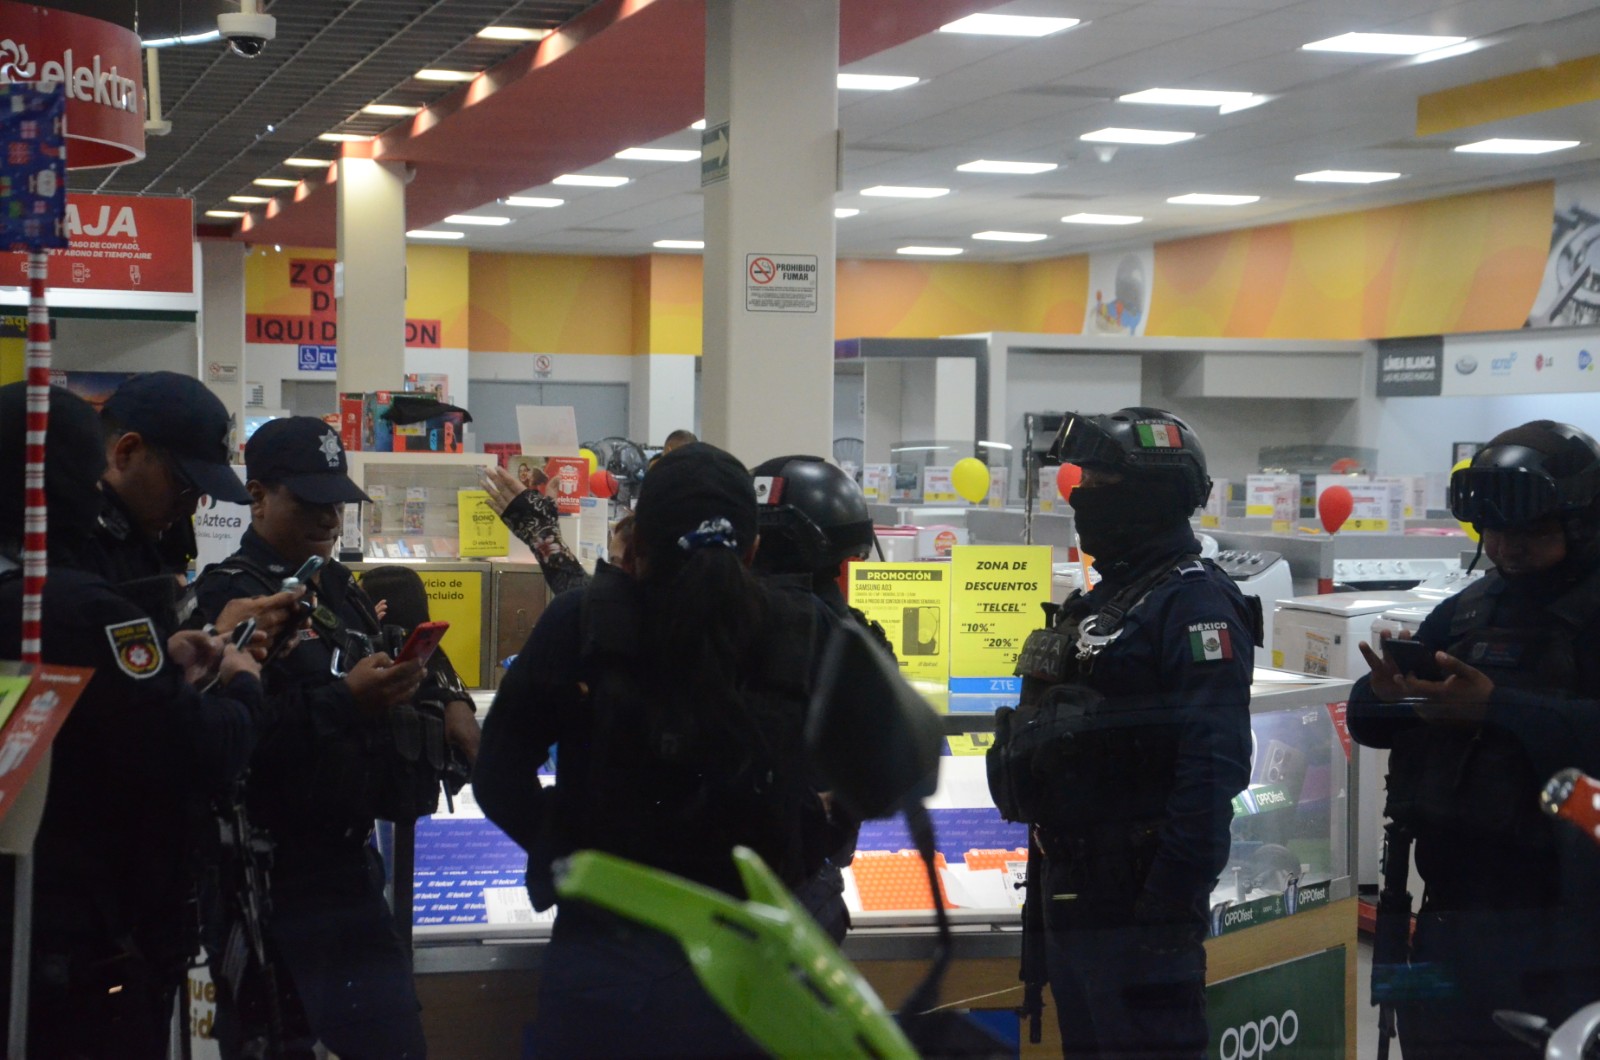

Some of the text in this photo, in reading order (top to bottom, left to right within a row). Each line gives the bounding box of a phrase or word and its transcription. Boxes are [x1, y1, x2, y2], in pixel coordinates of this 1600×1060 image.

[41, 48, 137, 113] elektra
[67, 203, 138, 237] AJA
[102, 242, 140, 250] CONTADO,
[776, 263, 816, 273] PROHIBIDO
[290, 263, 334, 286] ZO
[782, 272, 809, 281] FUMAR
[312, 291, 337, 312] D
[320, 352, 337, 364] EL
[203, 513, 242, 528] Azteca
[976, 561, 1028, 570] ZONA DE
[867, 571, 932, 581] PROMOCIÓN
[423, 579, 463, 588] vicio de
[964, 582, 1038, 591] DESCUENTOS
[425, 591, 464, 600] ncluido
[990, 679, 1016, 691] ZTE
[1220, 1009, 1299, 1060] oppo
